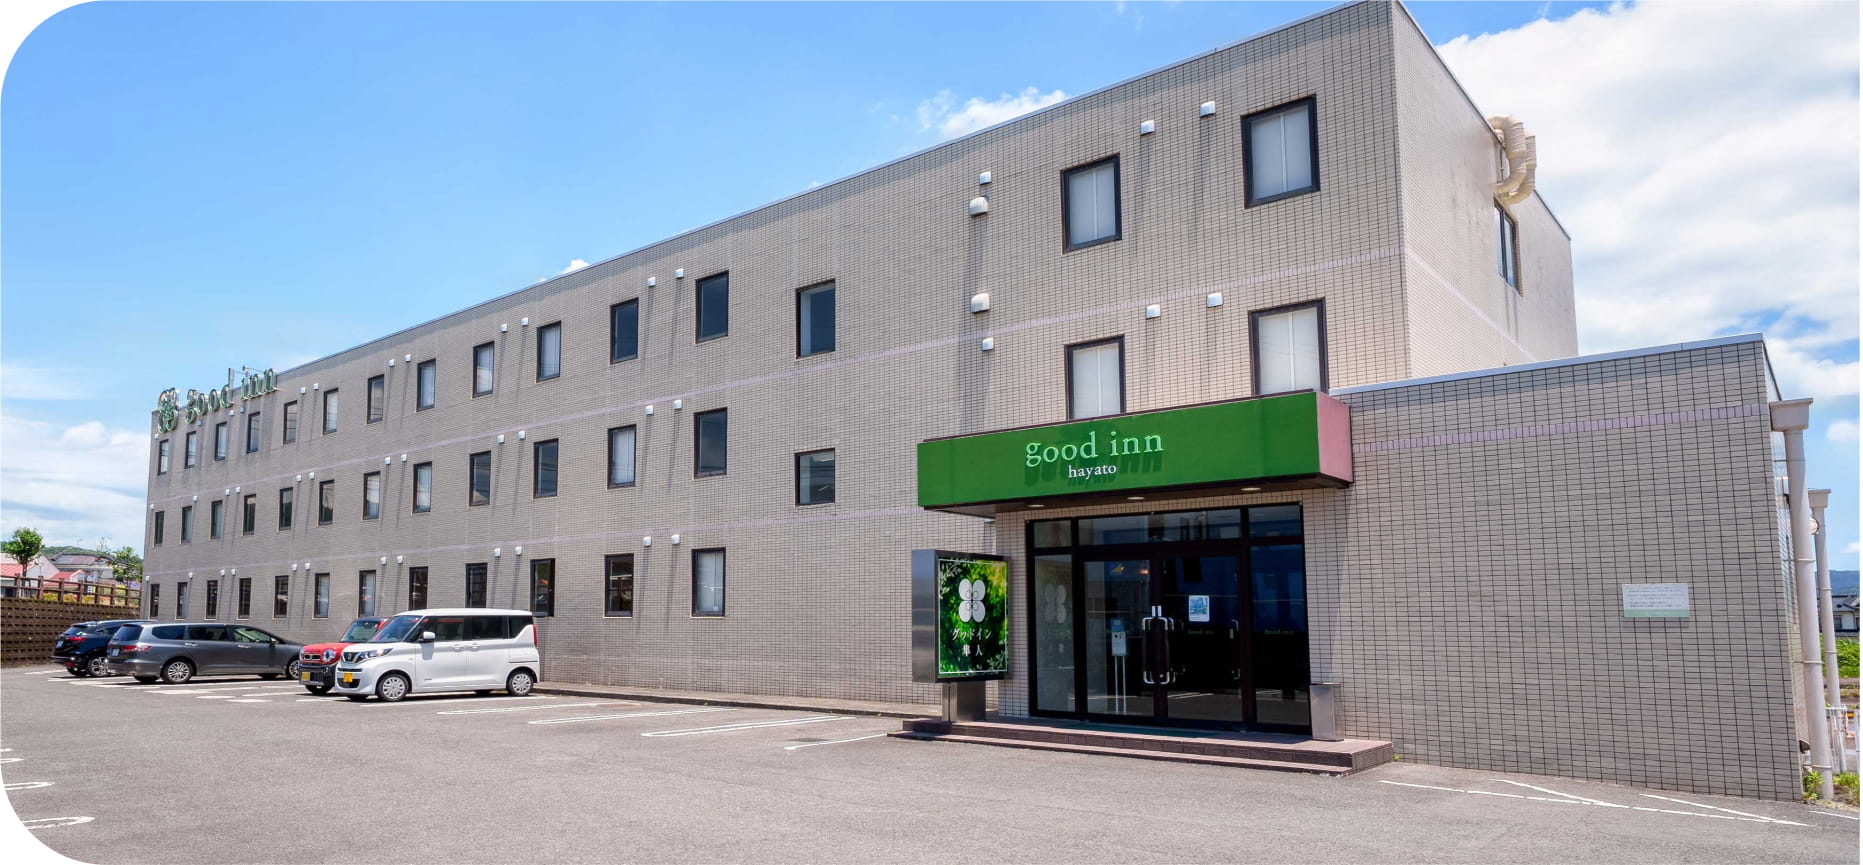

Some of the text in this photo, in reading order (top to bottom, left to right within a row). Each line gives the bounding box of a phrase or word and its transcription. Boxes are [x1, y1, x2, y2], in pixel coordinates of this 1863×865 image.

[185, 365, 278, 424] good inn
[1025, 430, 1164, 468] good inn
[1068, 464, 1117, 480] hayato
[952, 627, 993, 641] グッドイン
